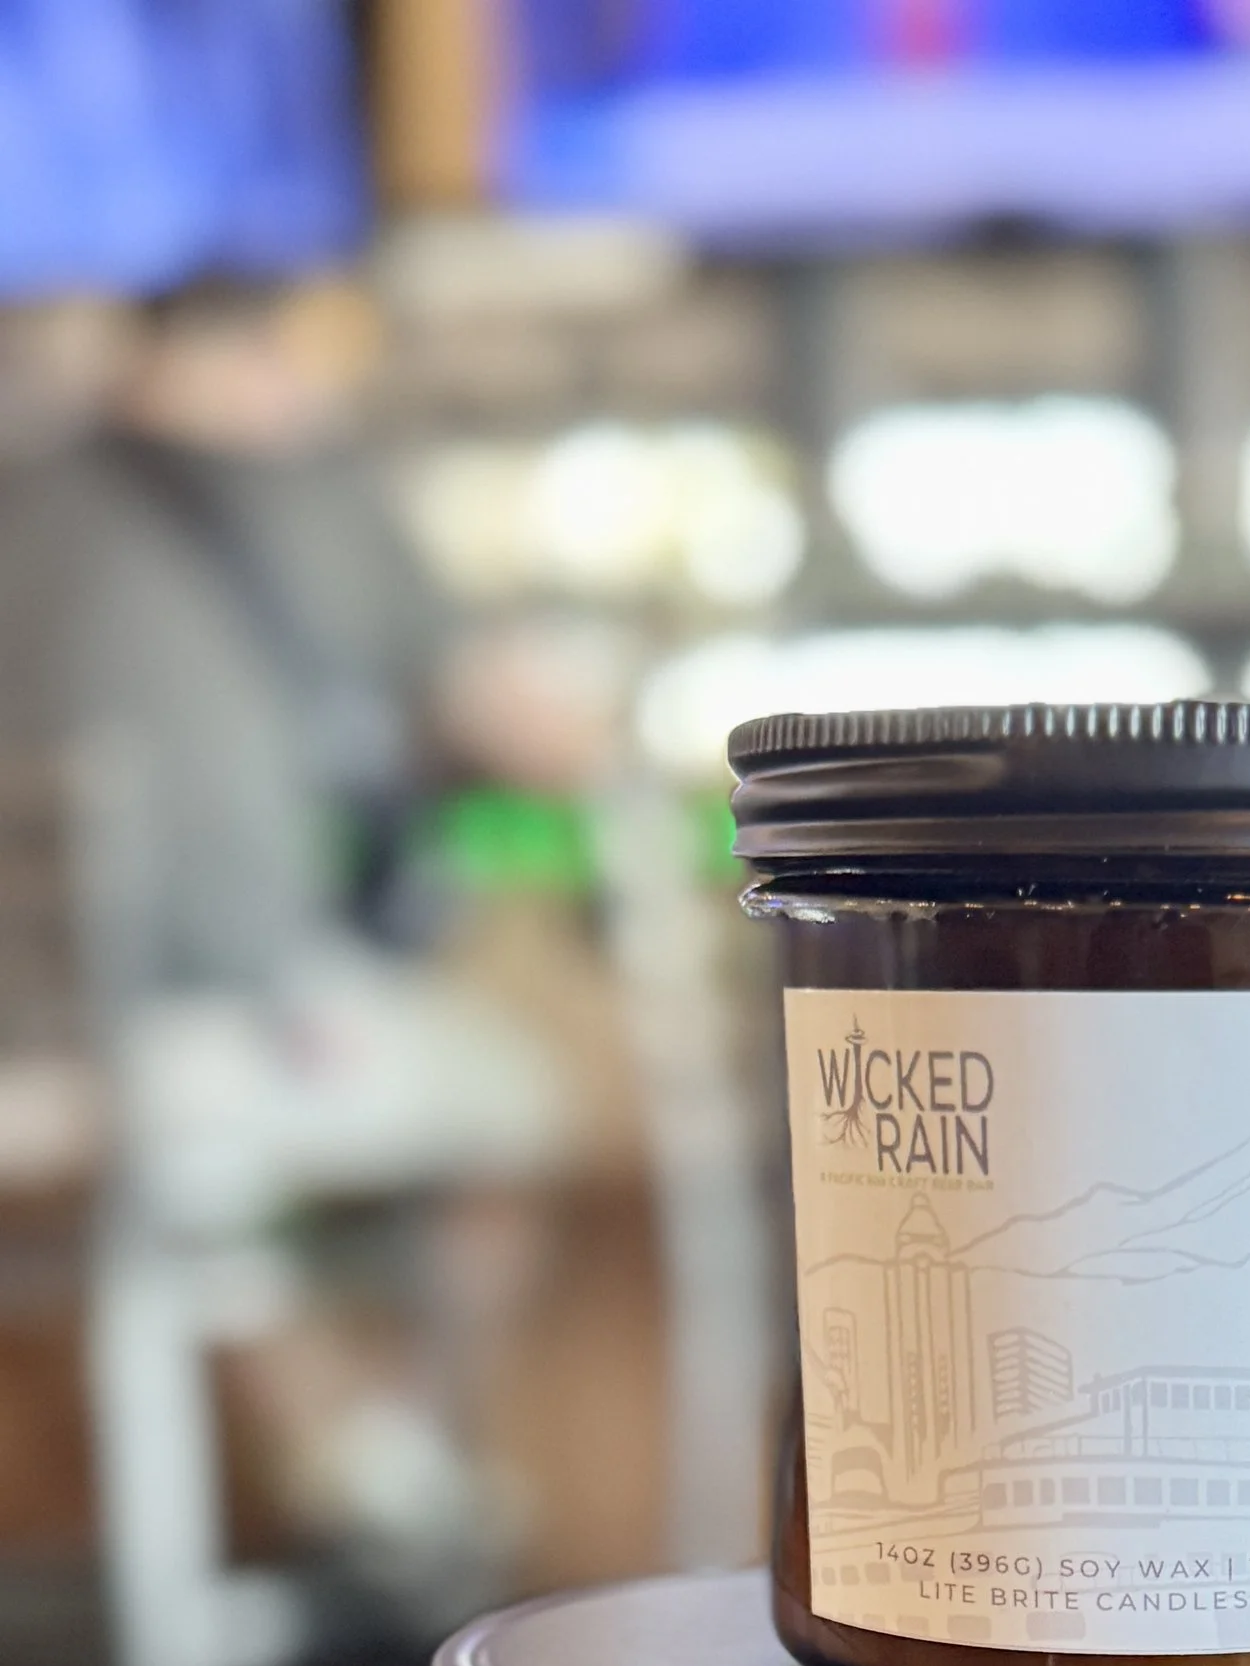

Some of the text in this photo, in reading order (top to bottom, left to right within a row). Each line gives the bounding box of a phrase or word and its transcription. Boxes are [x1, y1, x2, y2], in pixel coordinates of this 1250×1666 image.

[816, 1046, 994, 1113] WICKED
[875, 1111, 989, 1176] RAIN
[875, 1541, 936, 1568] 14OZ
[949, 1551, 1043, 1580] (396G)
[1059, 1558, 1121, 1579] SOY
[1138, 1558, 1210, 1579] WAX
[919, 1580, 977, 1604] LITE
[991, 1587, 1080, 1611] BRITE
[1096, 1589, 1248, 1612] CANDLES
